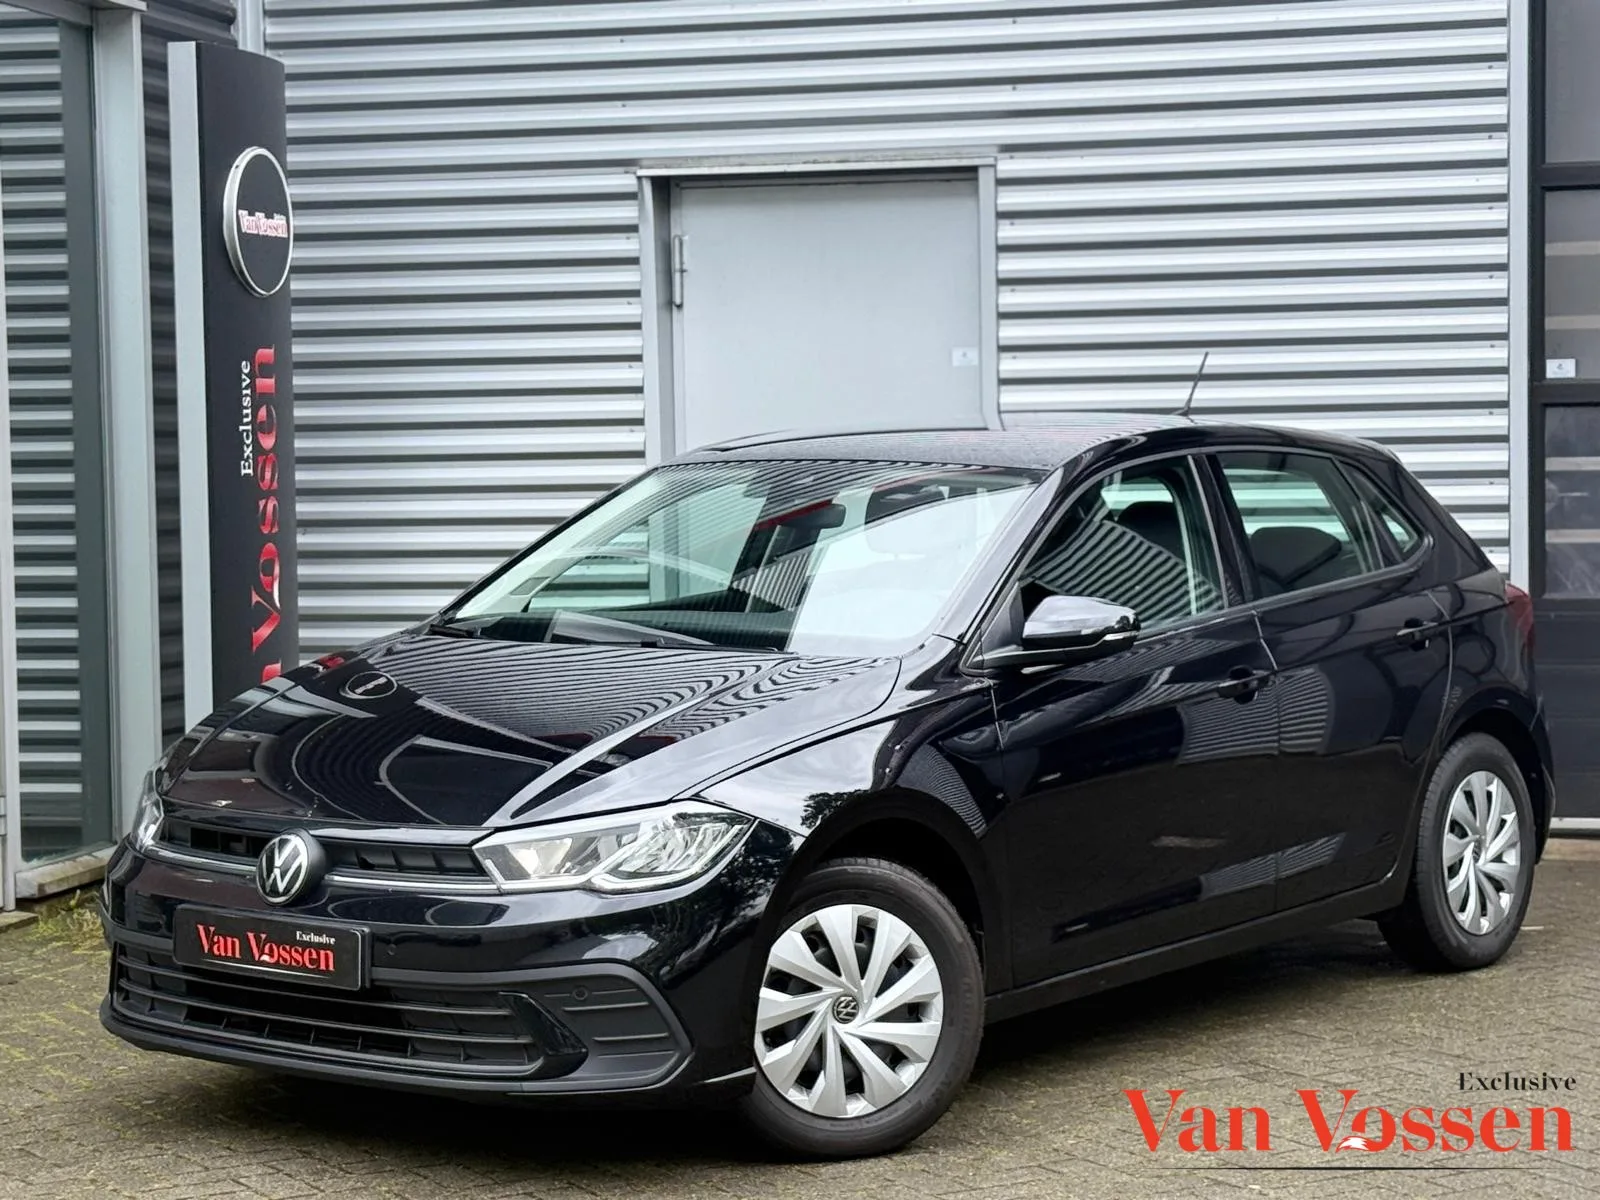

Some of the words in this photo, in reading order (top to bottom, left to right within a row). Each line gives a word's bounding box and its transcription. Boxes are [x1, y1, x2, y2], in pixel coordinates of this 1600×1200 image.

[239, 360, 254, 477] Exclusive
[251, 344, 281, 654] Vossen
[197, 924, 241, 959] Van
[246, 931, 335, 972] Vossen
[295, 930, 336, 945] Exclusive
